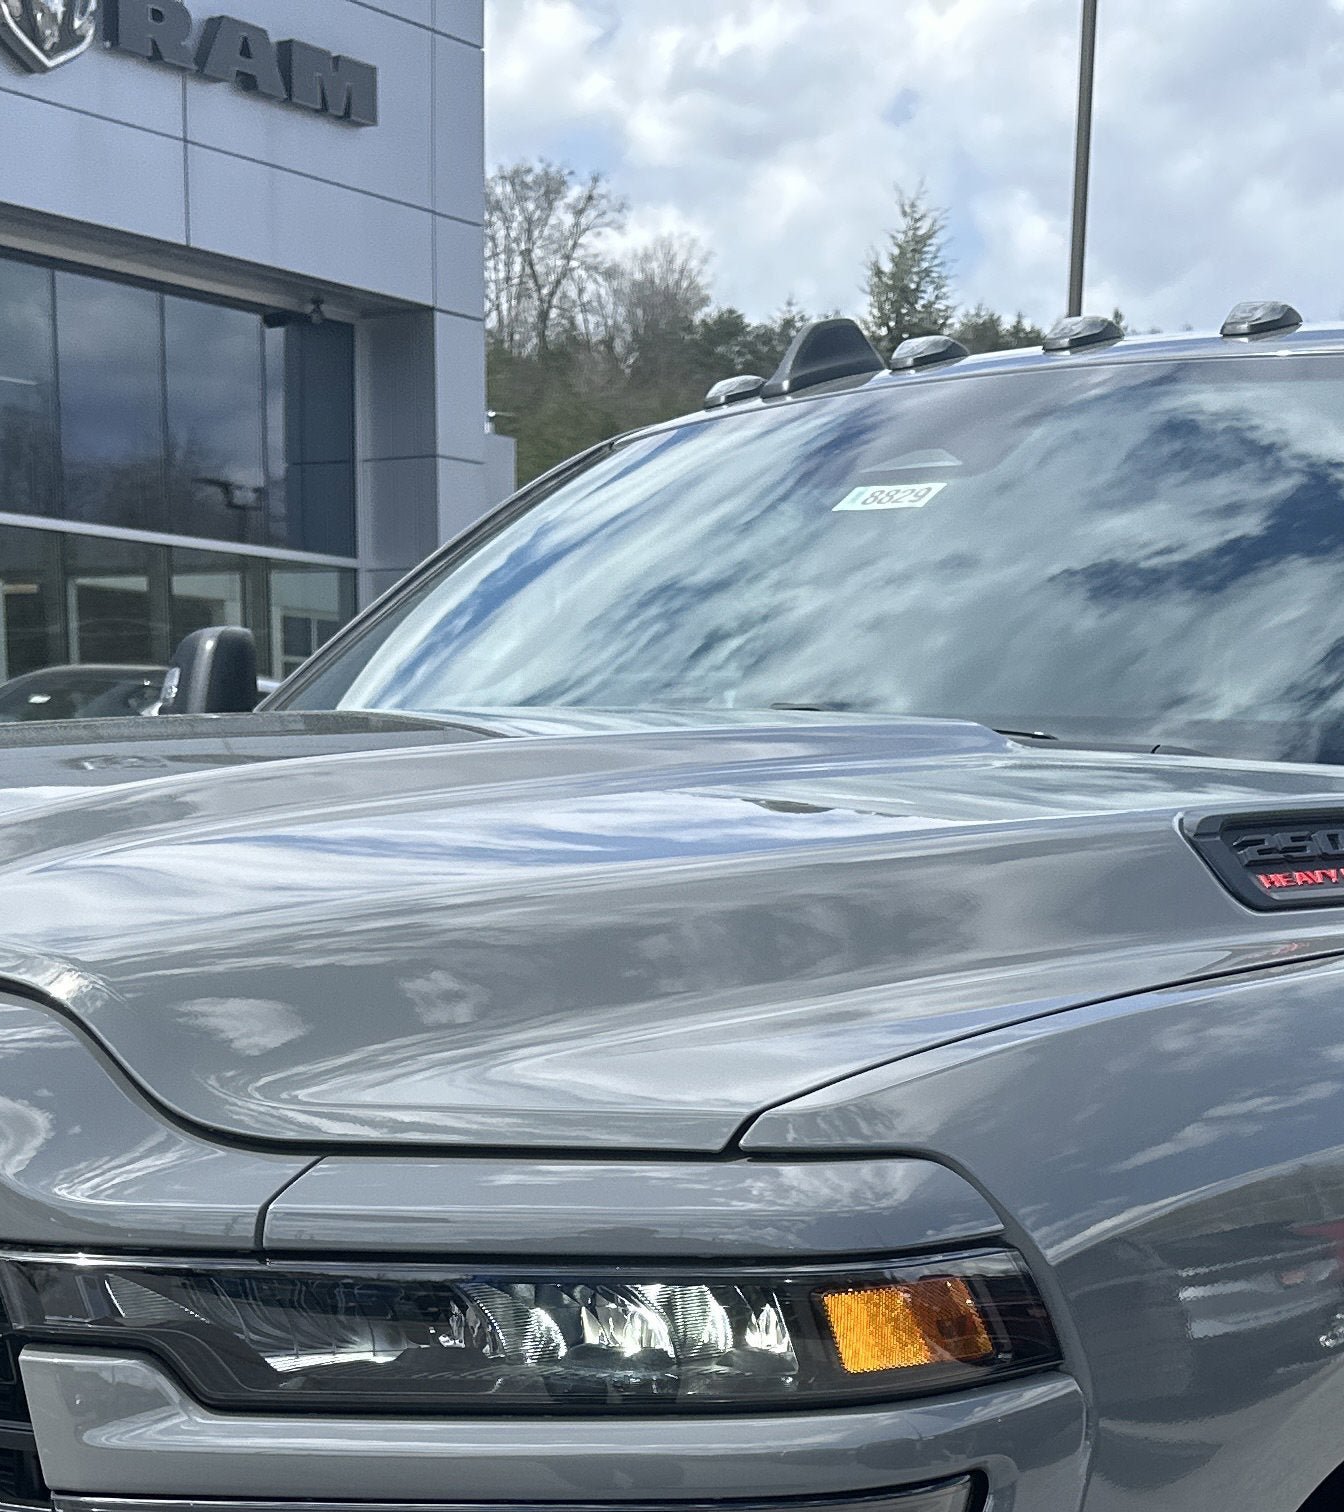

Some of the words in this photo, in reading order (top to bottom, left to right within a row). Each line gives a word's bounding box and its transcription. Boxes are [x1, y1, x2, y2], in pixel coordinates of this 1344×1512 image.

[103, 0, 378, 127] RAM
[861, 486, 932, 506] 8829
[1257, 868, 1338, 889] HEAVY
